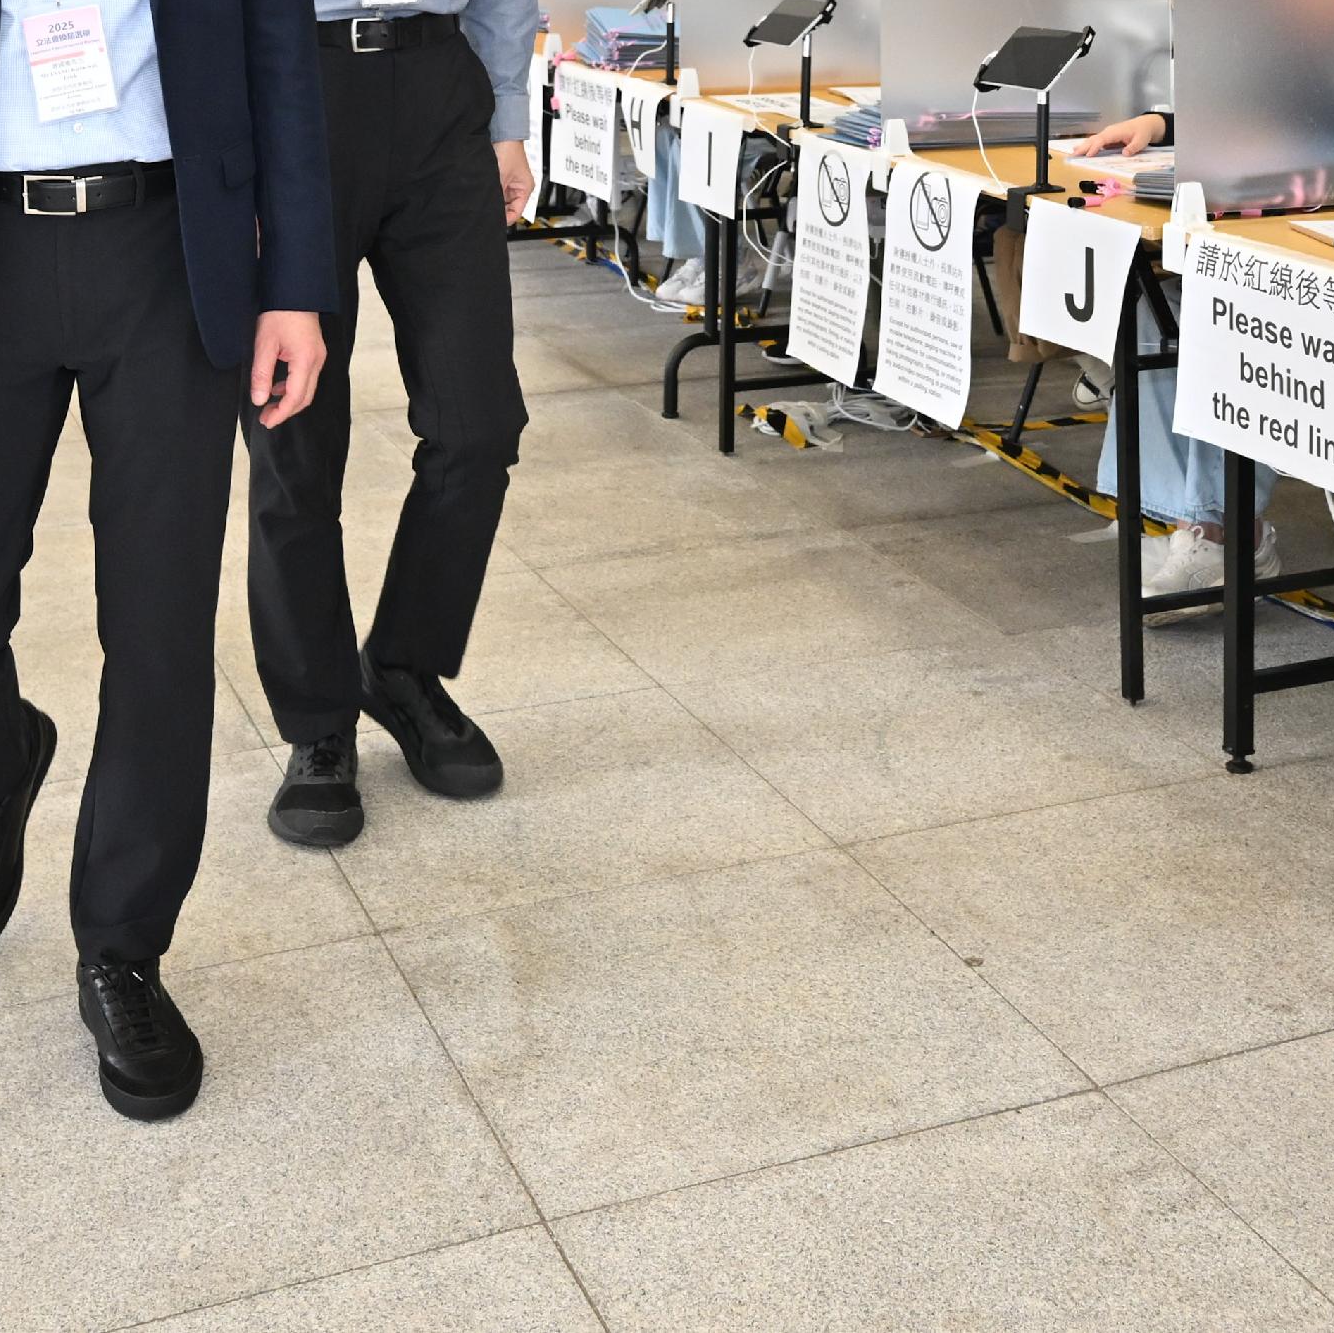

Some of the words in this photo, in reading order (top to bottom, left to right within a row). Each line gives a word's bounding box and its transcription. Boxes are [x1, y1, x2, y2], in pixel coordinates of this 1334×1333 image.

[48, 21, 75, 33] 2025
[565, 103, 590, 126] Please
[630, 97, 643, 150] H
[574, 132, 601, 156] behind
[707, 131, 712, 187] I
[566, 157, 580, 174] the
[581, 163, 594, 179] red
[596, 168, 608, 185] line
[1064, 247, 1094, 322] J
[1212, 298, 1292, 350] Please
[1240, 353, 1325, 410] behind
[1212, 393, 1250, 430] the
[1259, 416, 1298, 447] red
